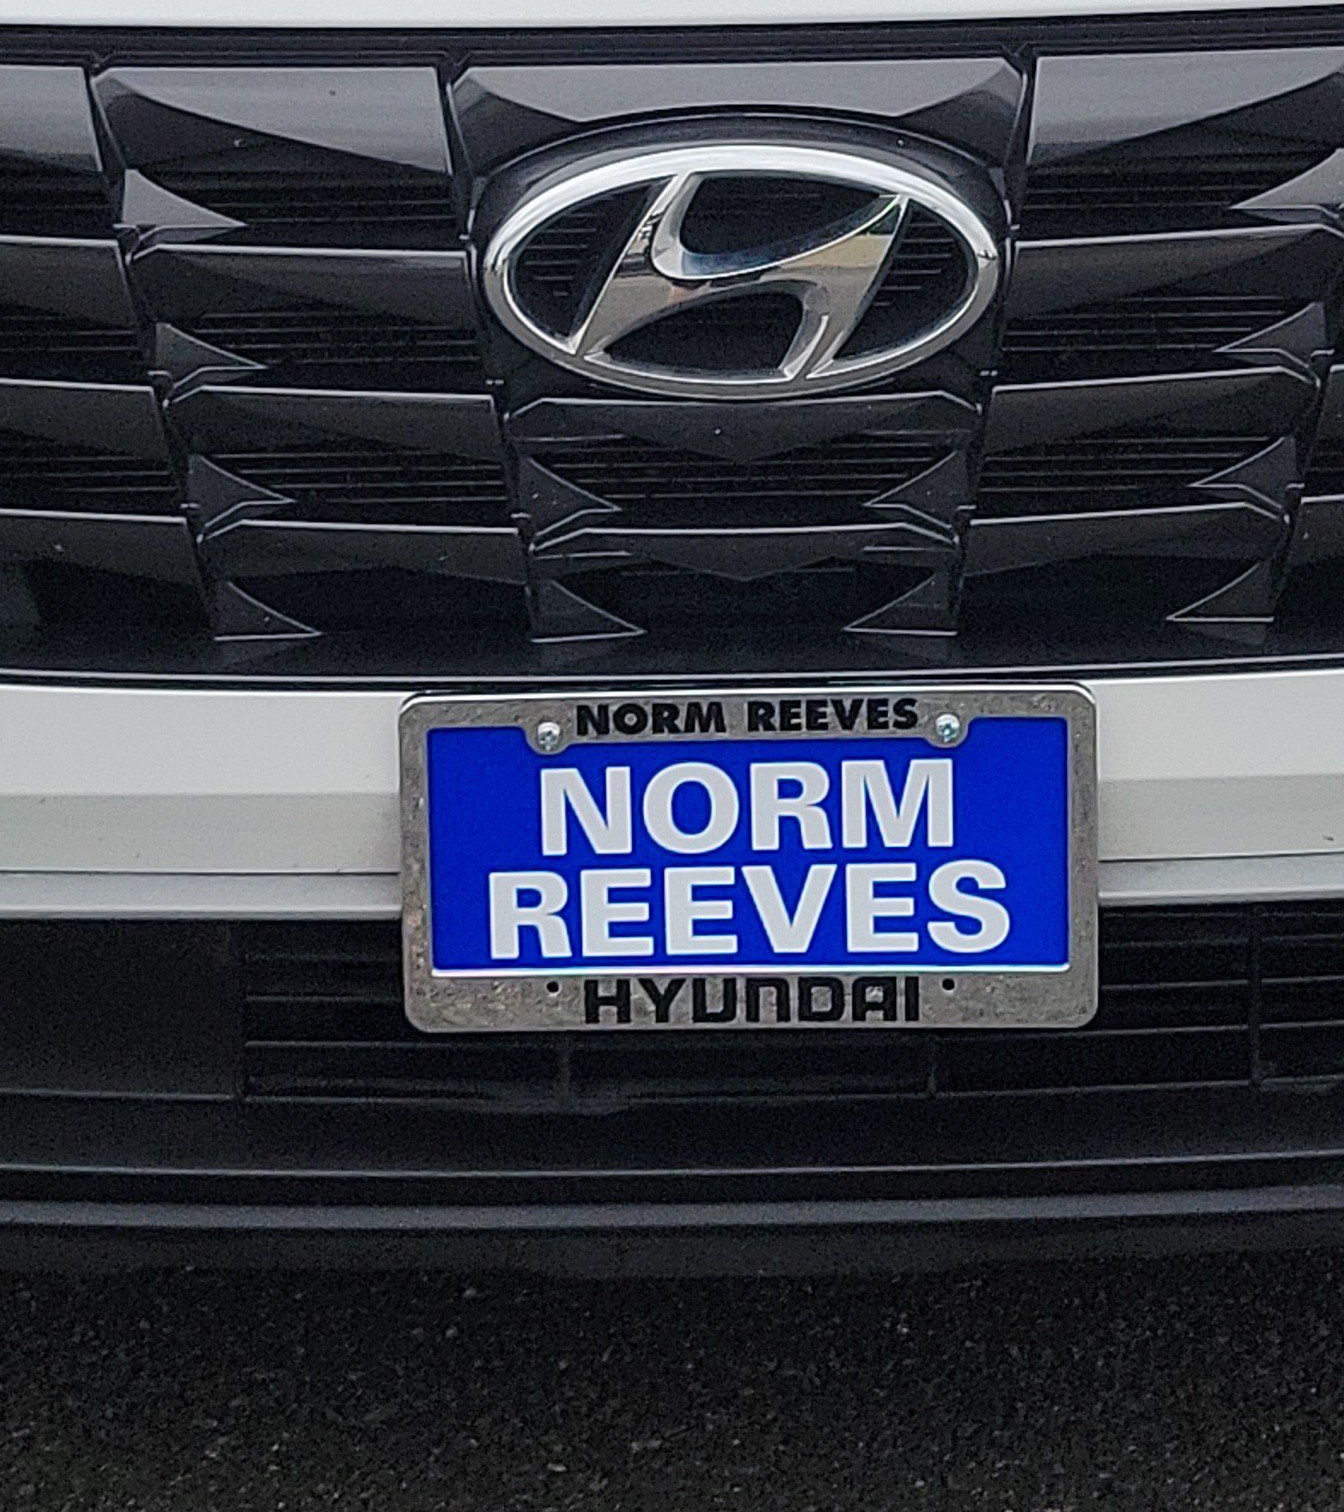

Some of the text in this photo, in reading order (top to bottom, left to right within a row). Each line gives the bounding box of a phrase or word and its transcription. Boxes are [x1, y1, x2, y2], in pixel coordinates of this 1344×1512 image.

[575, 698, 919, 736] NORM REEVES
[541, 759, 954, 856] NORM
[489, 860, 1010, 960] REEVES
[583, 976, 920, 1025] HYUNDAI
